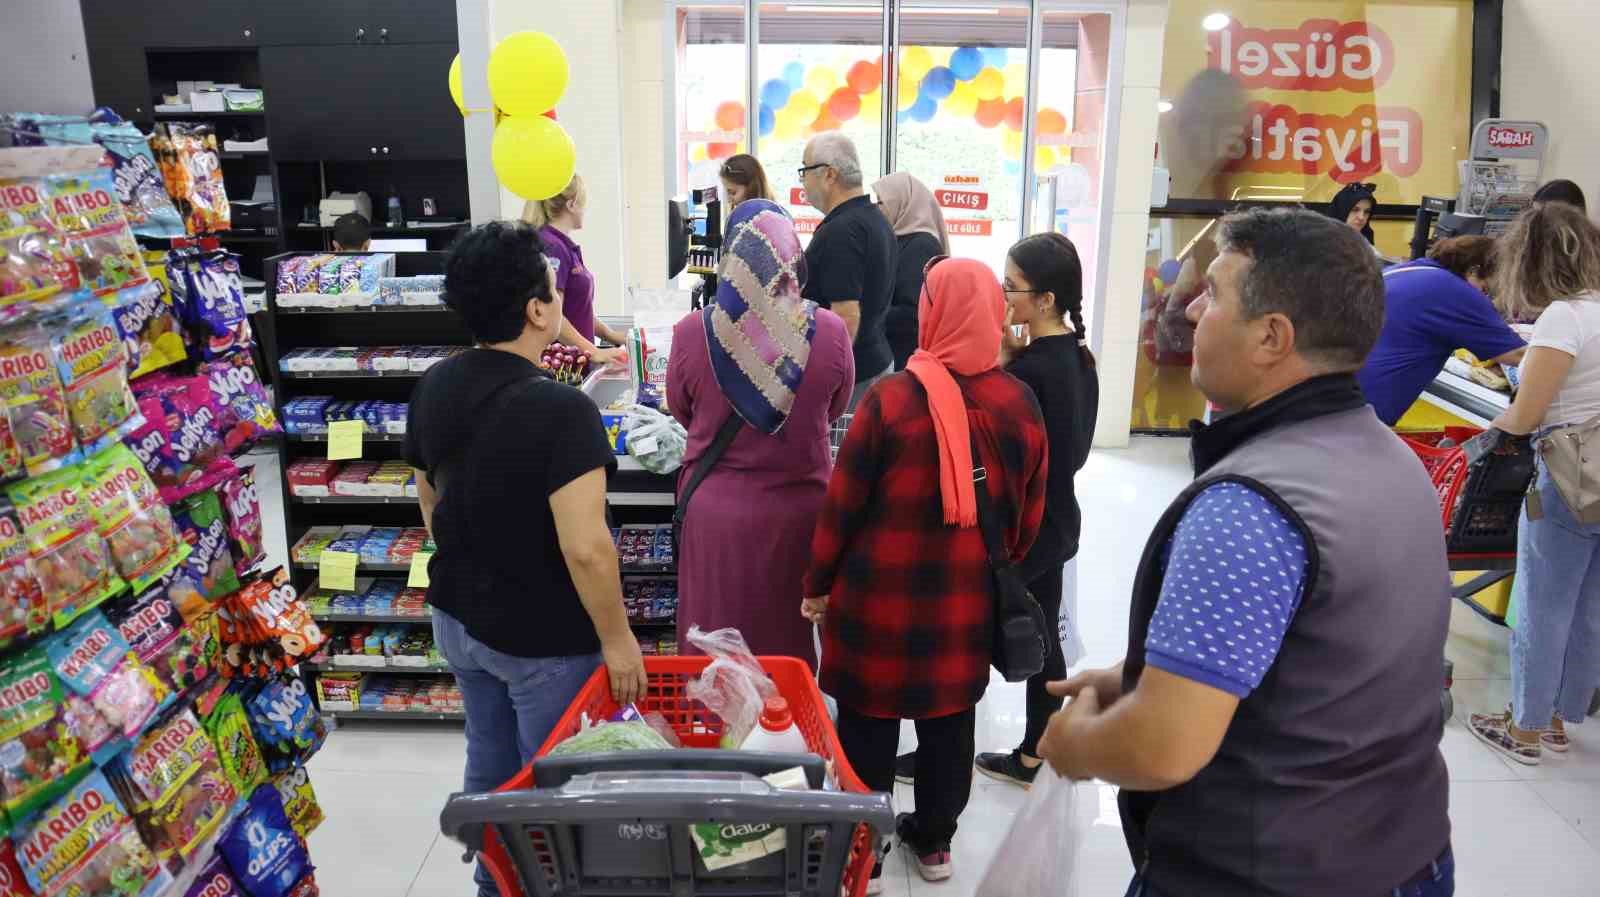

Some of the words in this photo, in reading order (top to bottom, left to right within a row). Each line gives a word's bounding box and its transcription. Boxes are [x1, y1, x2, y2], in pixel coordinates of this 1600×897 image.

[1489, 129, 1533, 146] SABAH
[0, 186, 38, 208] IBO
[943, 192, 980, 207] ÇIKIŞ
[960, 222, 981, 233] GÜLE
[63, 326, 113, 362] HARIBO
[0, 352, 47, 379] RIBO
[190, 518, 224, 574] Jelibon
[0, 672, 50, 707] RIBO
[23, 790, 103, 866] HARIBO
